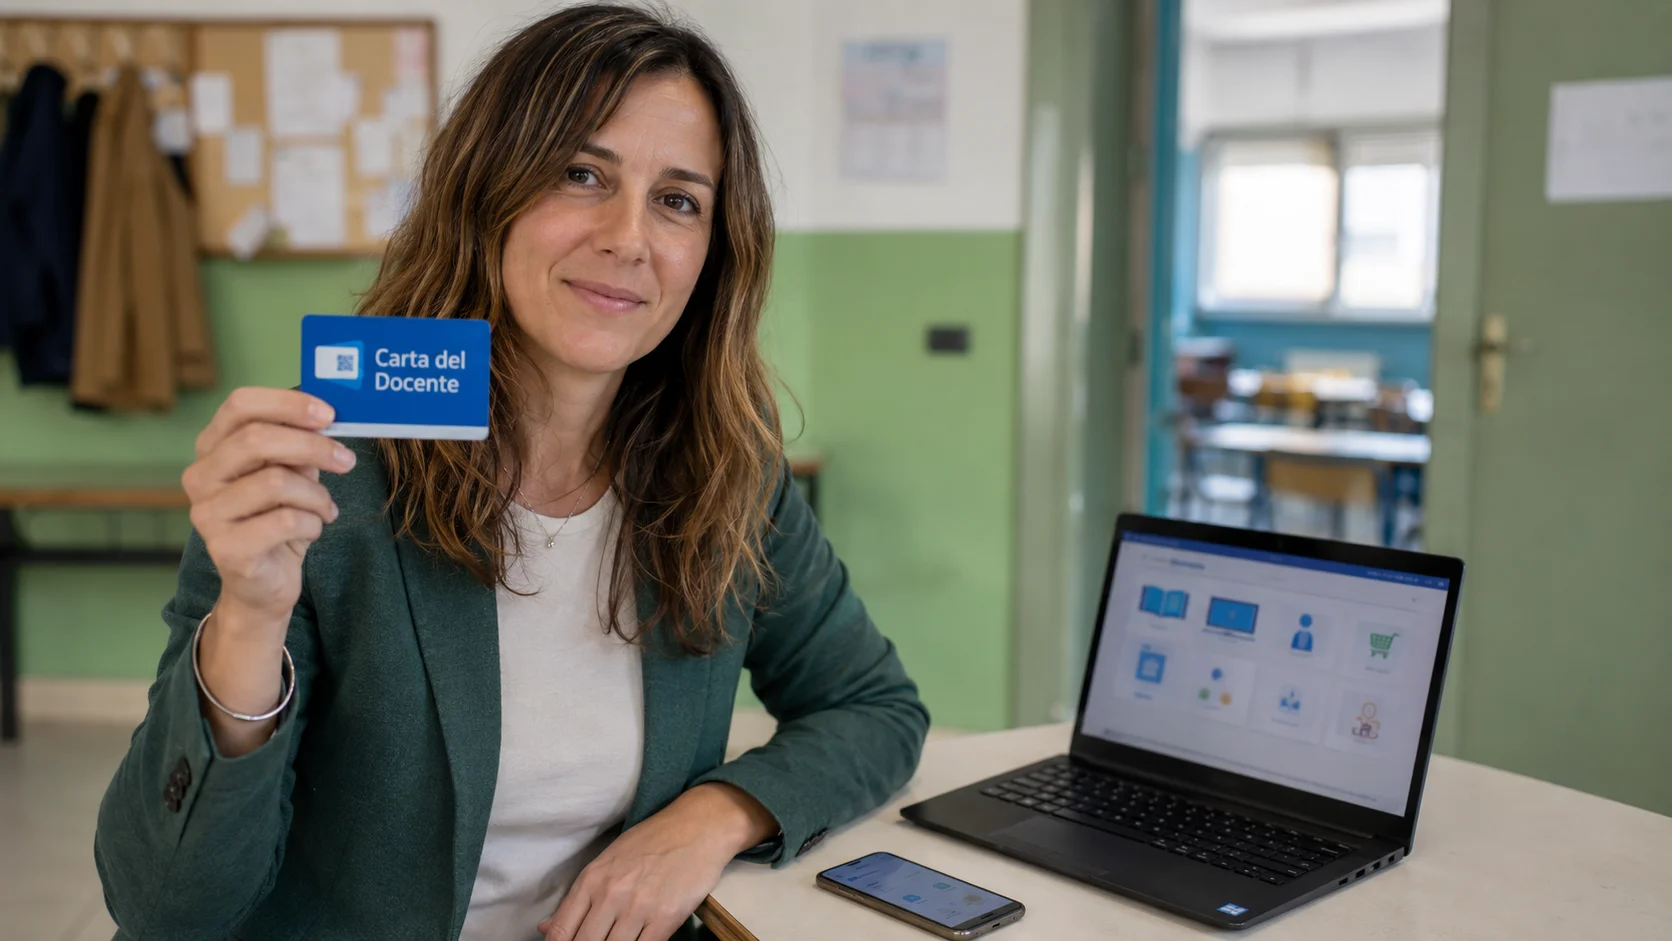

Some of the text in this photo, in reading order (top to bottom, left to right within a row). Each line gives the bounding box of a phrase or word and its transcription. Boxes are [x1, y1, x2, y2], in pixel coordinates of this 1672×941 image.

[375, 348, 466, 369] Carta del
[375, 372, 460, 393] Docente
